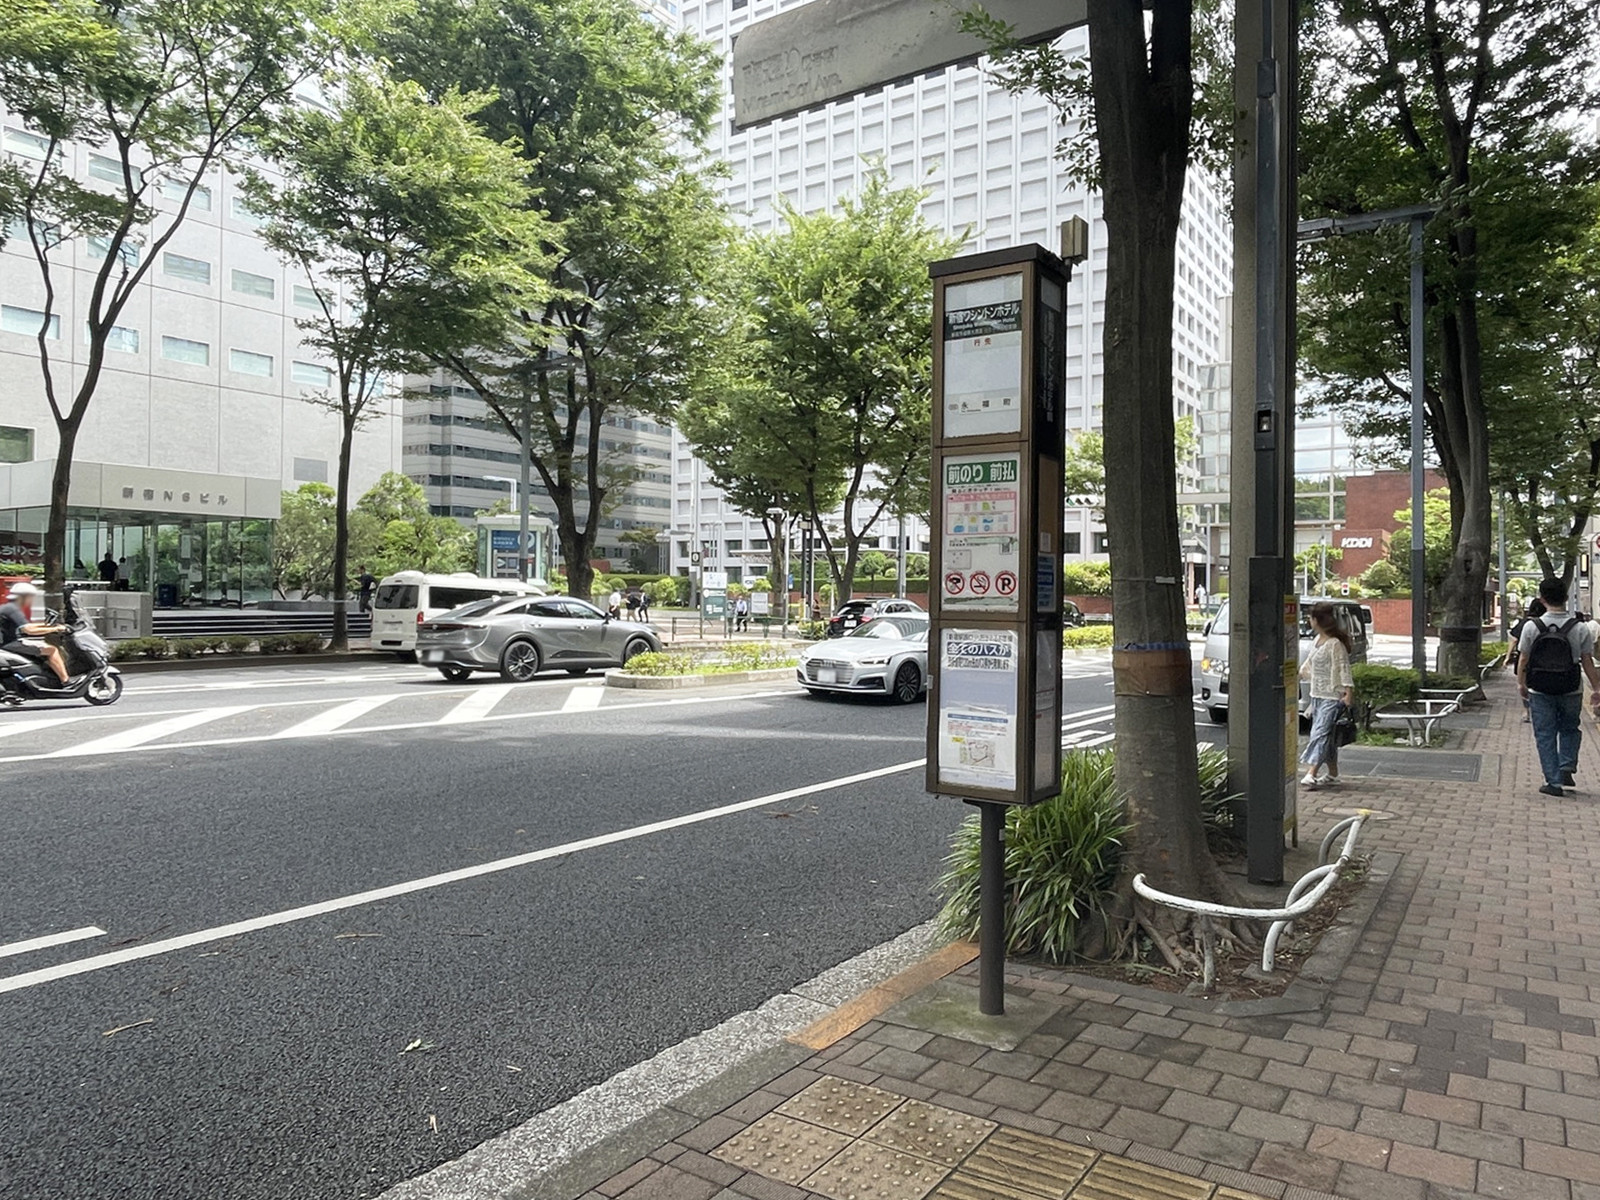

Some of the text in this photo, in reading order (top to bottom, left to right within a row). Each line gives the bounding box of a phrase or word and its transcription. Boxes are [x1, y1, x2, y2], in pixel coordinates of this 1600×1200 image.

[948, 465, 984, 484] 前のり
[1341, 537, 1373, 549] KDDI
